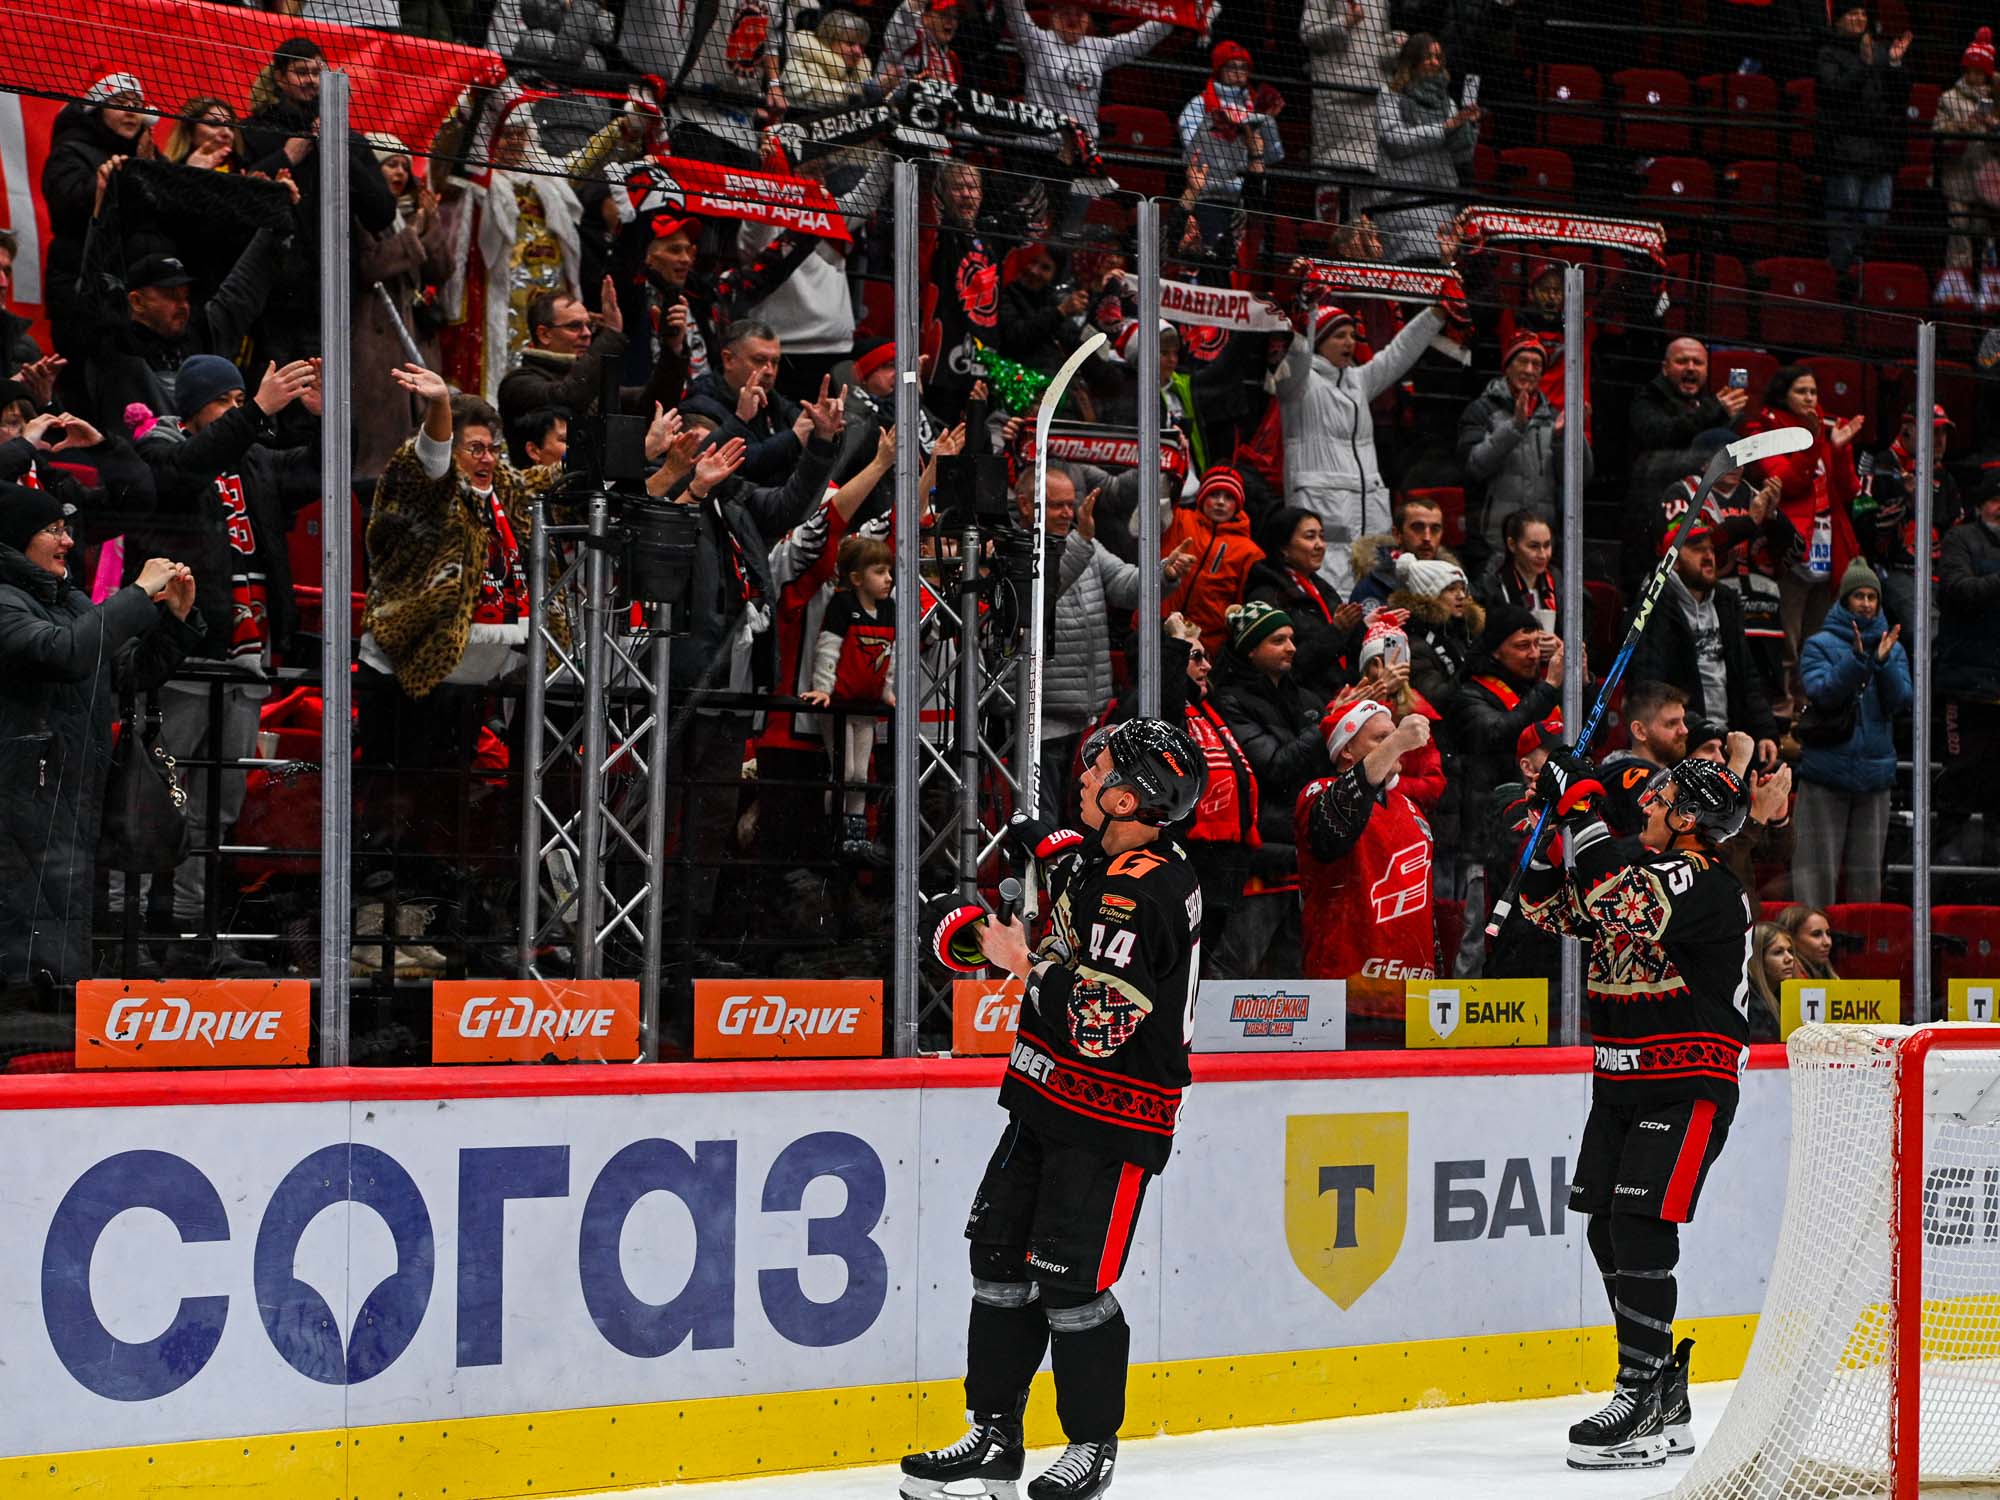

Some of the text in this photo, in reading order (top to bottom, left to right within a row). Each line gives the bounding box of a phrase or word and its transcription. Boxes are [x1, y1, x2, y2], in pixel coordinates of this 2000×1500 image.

[724, 173, 806, 205] ВРЕМЯ
[701, 189, 831, 231] АВАНГАРДА
[1161, 284, 1250, 324] АВАНГАРД
[1633, 545, 1679, 632] CCM
[1571, 694, 1605, 759] JETSPE
[1136, 776, 1157, 795] CCM
[1088, 923, 1137, 969] 44
[1465, 1001, 1526, 1024] БАНК
[1830, 1000, 1881, 1021] БАНК
[1010, 1039, 1056, 1084] NBET
[1639, 1120, 1671, 1132] CCM
[1433, 1156, 1579, 1243] БАН
[1626, 1407, 1658, 1441] CCM
